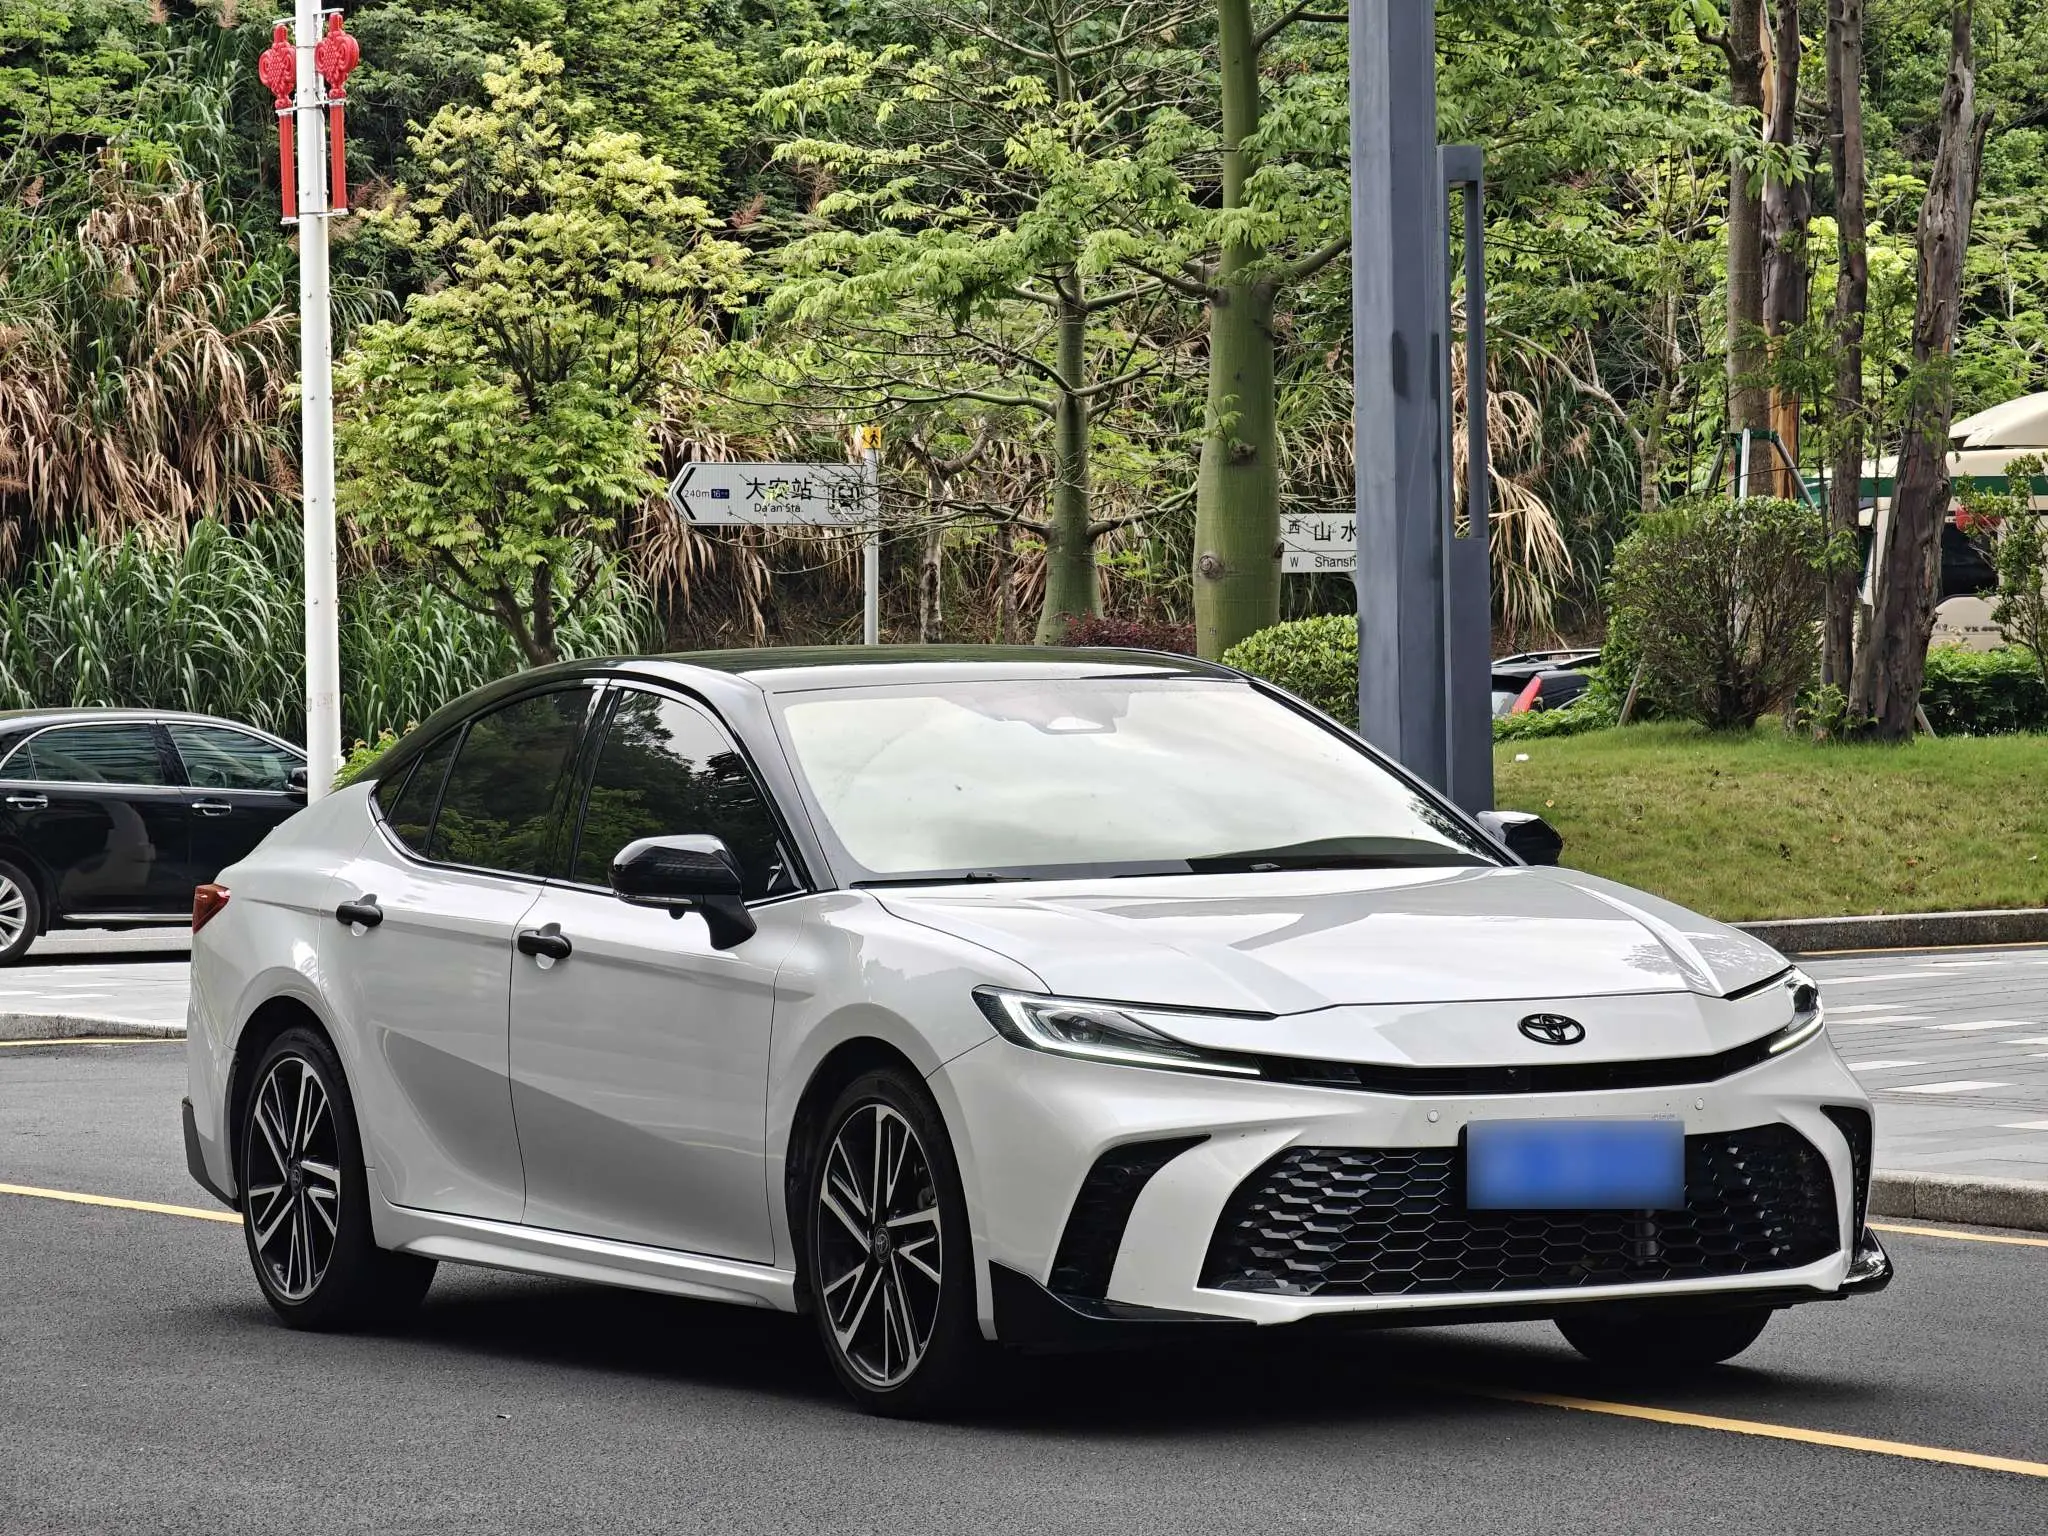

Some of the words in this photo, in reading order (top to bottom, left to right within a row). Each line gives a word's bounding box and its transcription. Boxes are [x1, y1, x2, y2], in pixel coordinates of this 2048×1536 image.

[684, 489, 710, 498] 240m
[1288, 520, 1300, 534] 西
[1289, 556, 1299, 568] W
